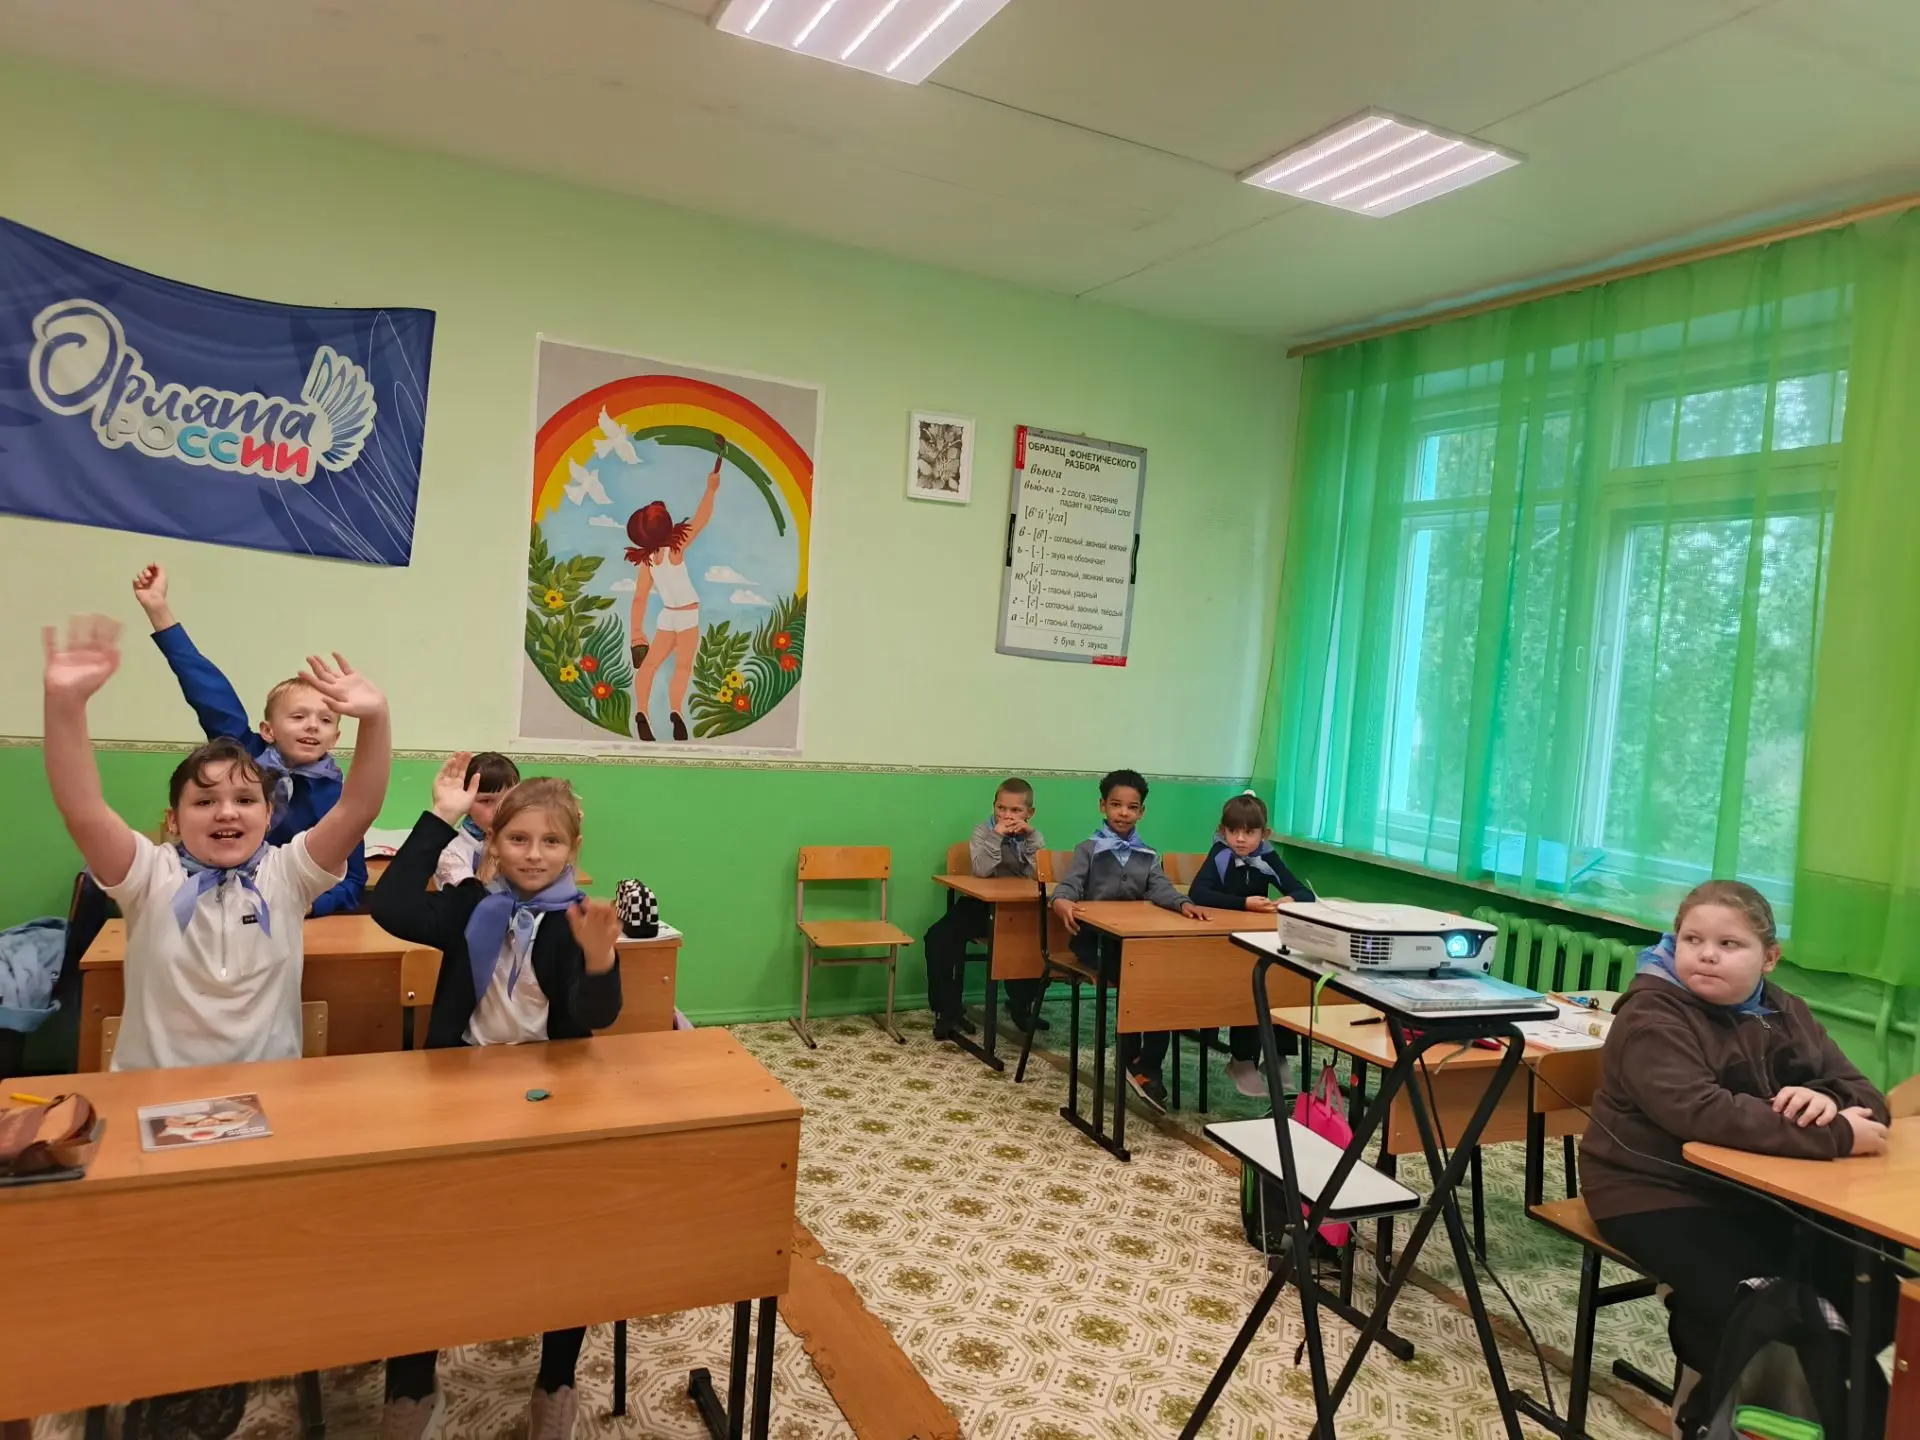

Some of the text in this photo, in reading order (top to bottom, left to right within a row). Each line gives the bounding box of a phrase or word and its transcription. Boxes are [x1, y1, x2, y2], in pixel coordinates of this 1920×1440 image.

[36, 304, 317, 447] Орлята
[105, 414, 309, 478] РОССИИ
[1028, 441, 1066, 457] ОБРАЗЕЦ
[1069, 449, 1137, 470] ФОНЕТИЧЕСКОГО
[1030, 463, 1062, 479] вьюга
[1064, 458, 1101, 473] РАЗБОРА
[1061, 487, 1067, 496] 2
[1067, 489, 1088, 500] слога,
[1088, 493, 1119, 505] ударение
[1060, 499, 1131, 517] падает на первый слог
[1051, 552, 1066, 561] звука
[1073, 554, 1106, 566] обозначает
[1070, 619, 1104, 631] безударный
[1053, 635, 1060, 645] 5
[1079, 638, 1085, 648] 5
[1087, 641, 1108, 651] звуков
